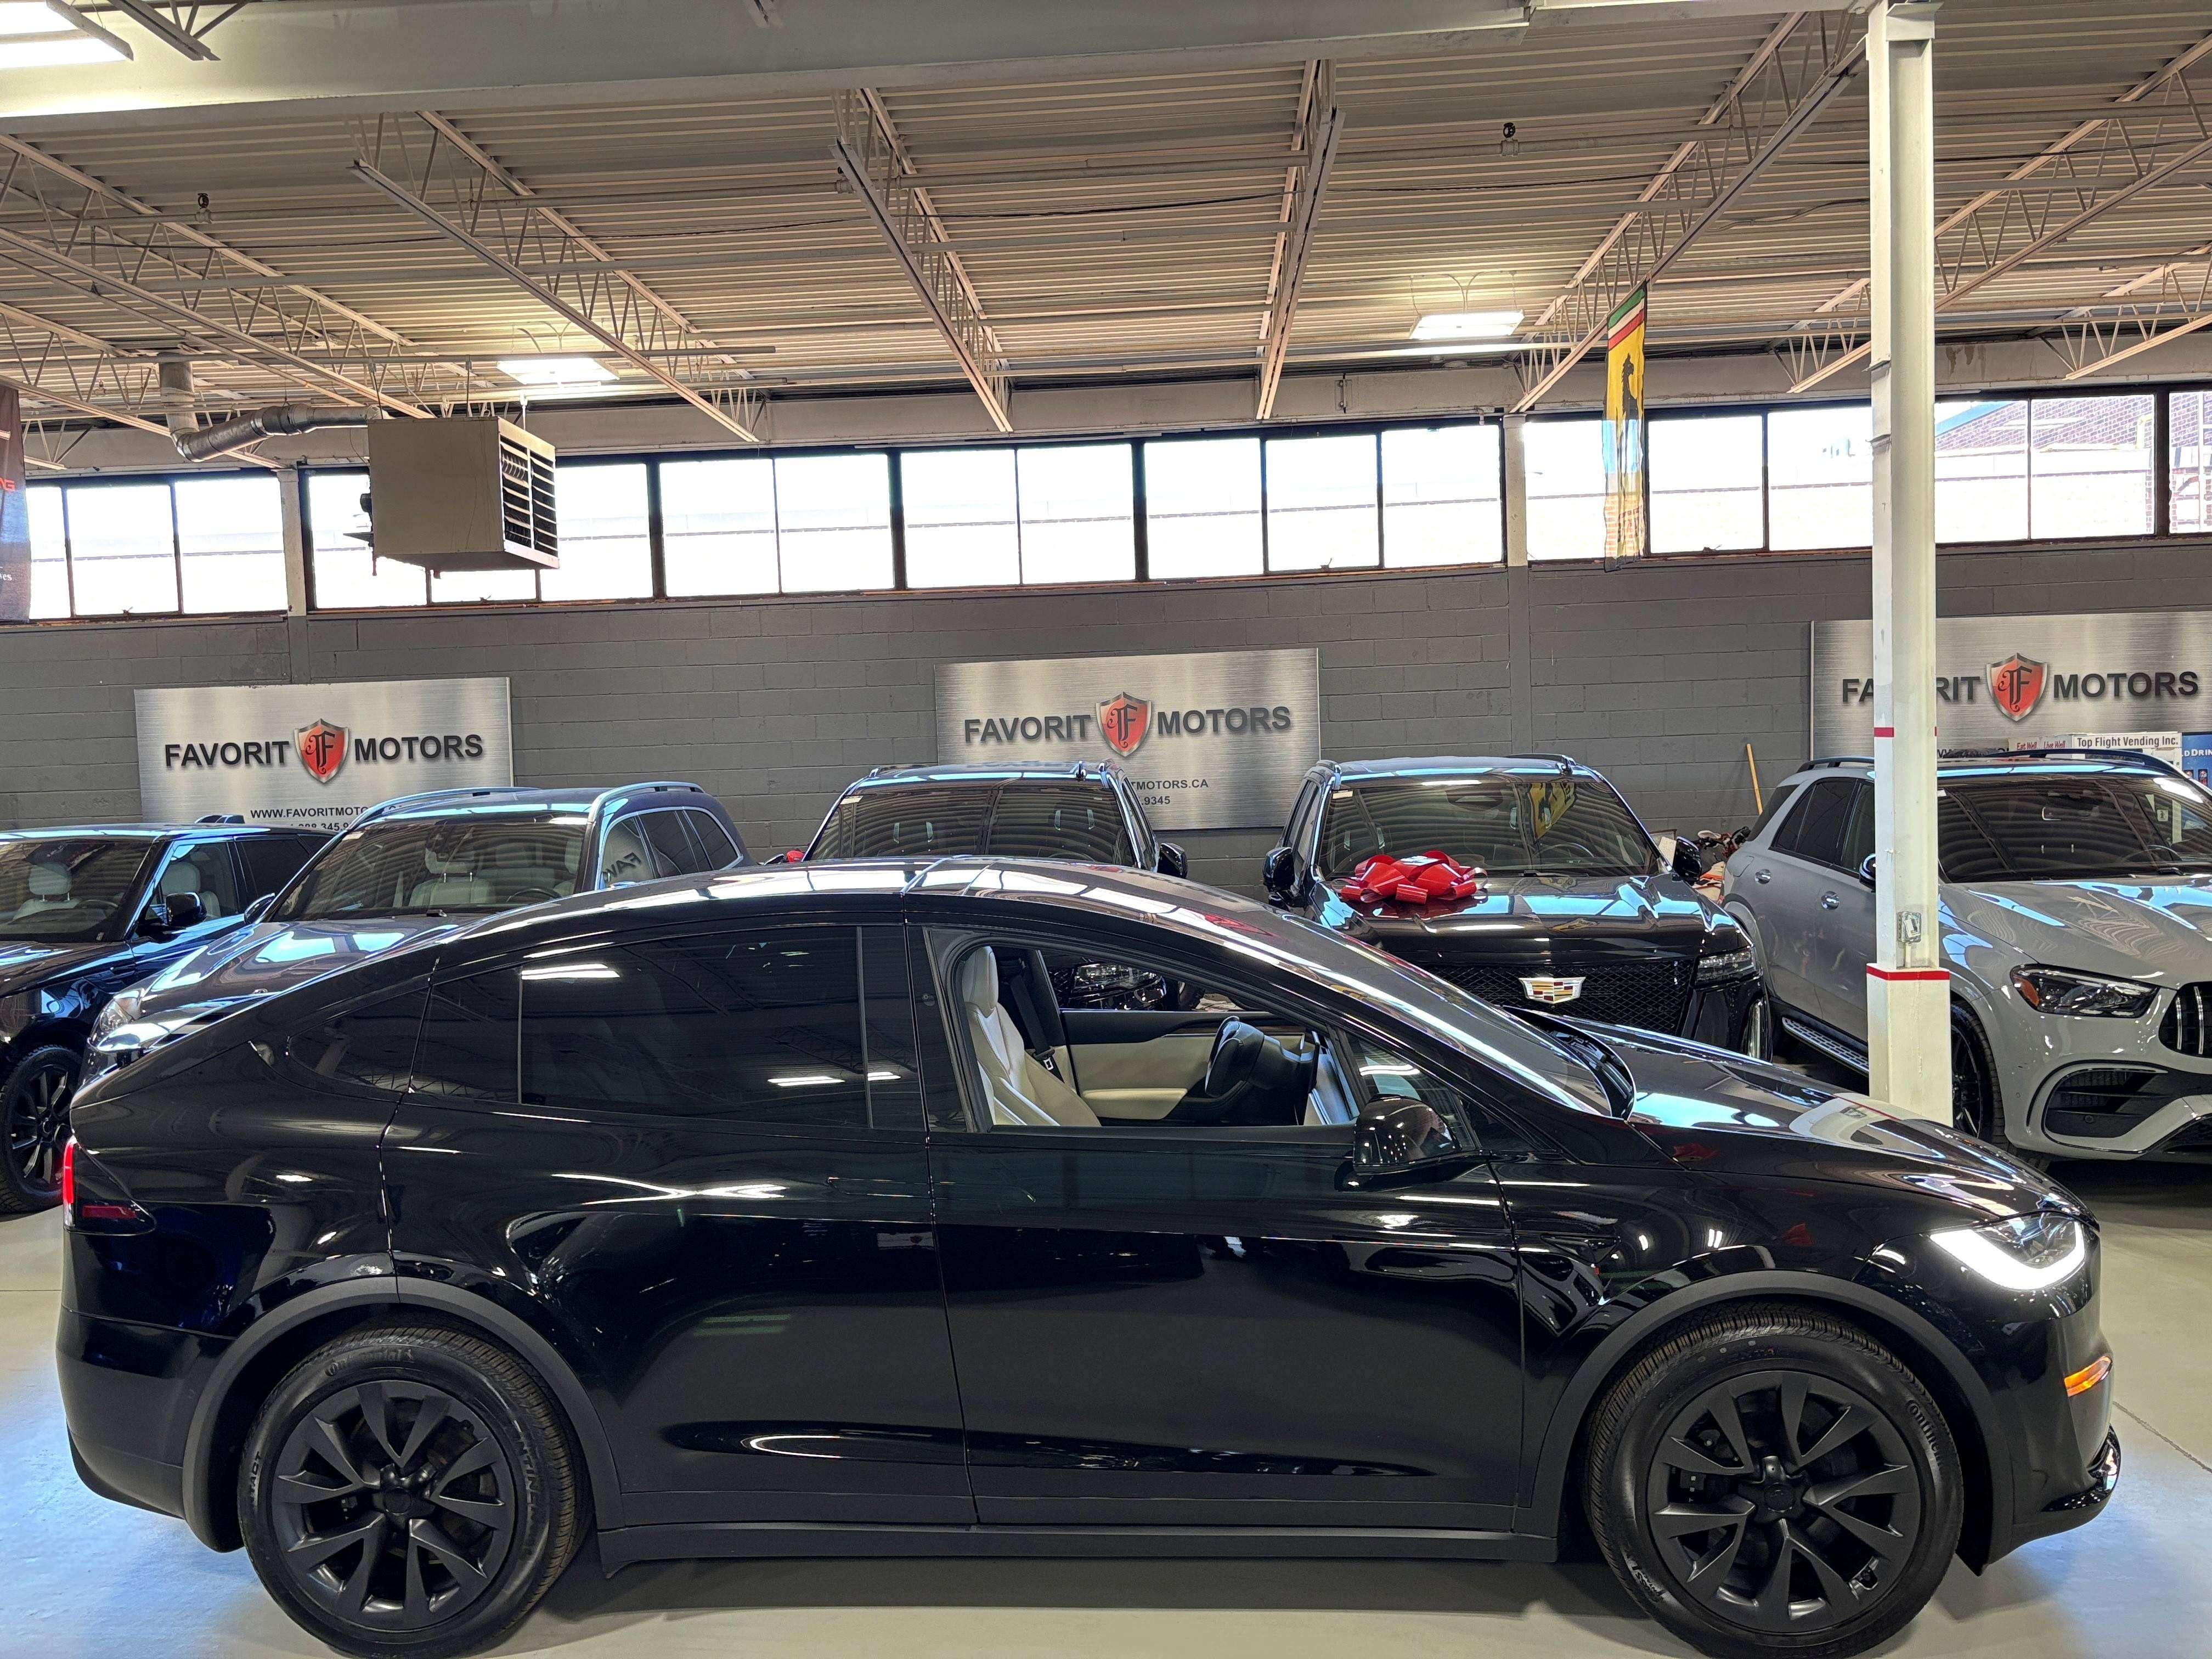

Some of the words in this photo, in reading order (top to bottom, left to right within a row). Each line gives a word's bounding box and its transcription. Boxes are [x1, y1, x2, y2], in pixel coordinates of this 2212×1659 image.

[1842, 676, 1980, 703] FARIT
[2054, 672, 2198, 698] MOTORS
[964, 714, 1091, 742] FAVORIT
[1158, 706, 1291, 735] MOTORS
[165, 741, 290, 767] FAVORIT
[354, 734, 483, 761] MOTORS
[2077, 737, 2092, 748] Top
[2095, 737, 2120, 748] Flight
[2123, 736, 2159, 747] Vending
[2163, 735, 2179, 745] Inc.
